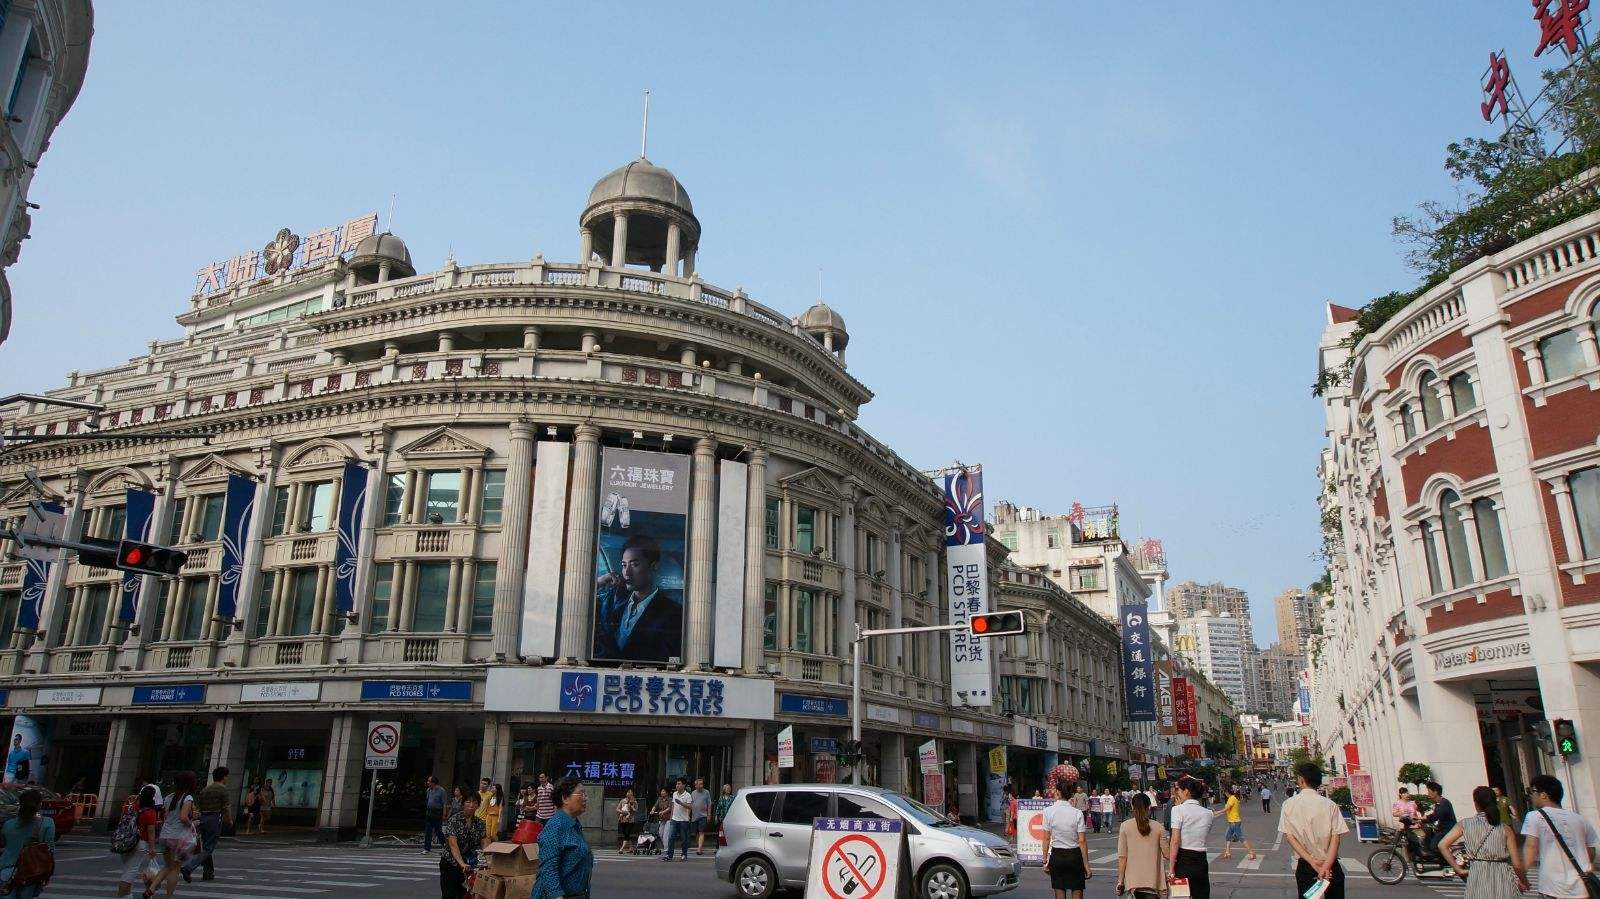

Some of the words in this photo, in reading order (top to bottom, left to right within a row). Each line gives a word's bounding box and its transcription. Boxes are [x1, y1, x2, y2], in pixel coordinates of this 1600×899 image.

[610, 465, 674, 484] 六福珠寶
[640, 482, 674, 491] JEWELLERY
[952, 565, 965, 596] PCD
[1130, 632, 1147, 698] 交通銀行
[604, 674, 724, 700] 巴黎春天百货
[602, 695, 643, 713] PCD
[648, 697, 724, 716] STORES
[566, 761, 635, 778] 六福珠寶
[827, 819, 890, 831] 无烟商业街
